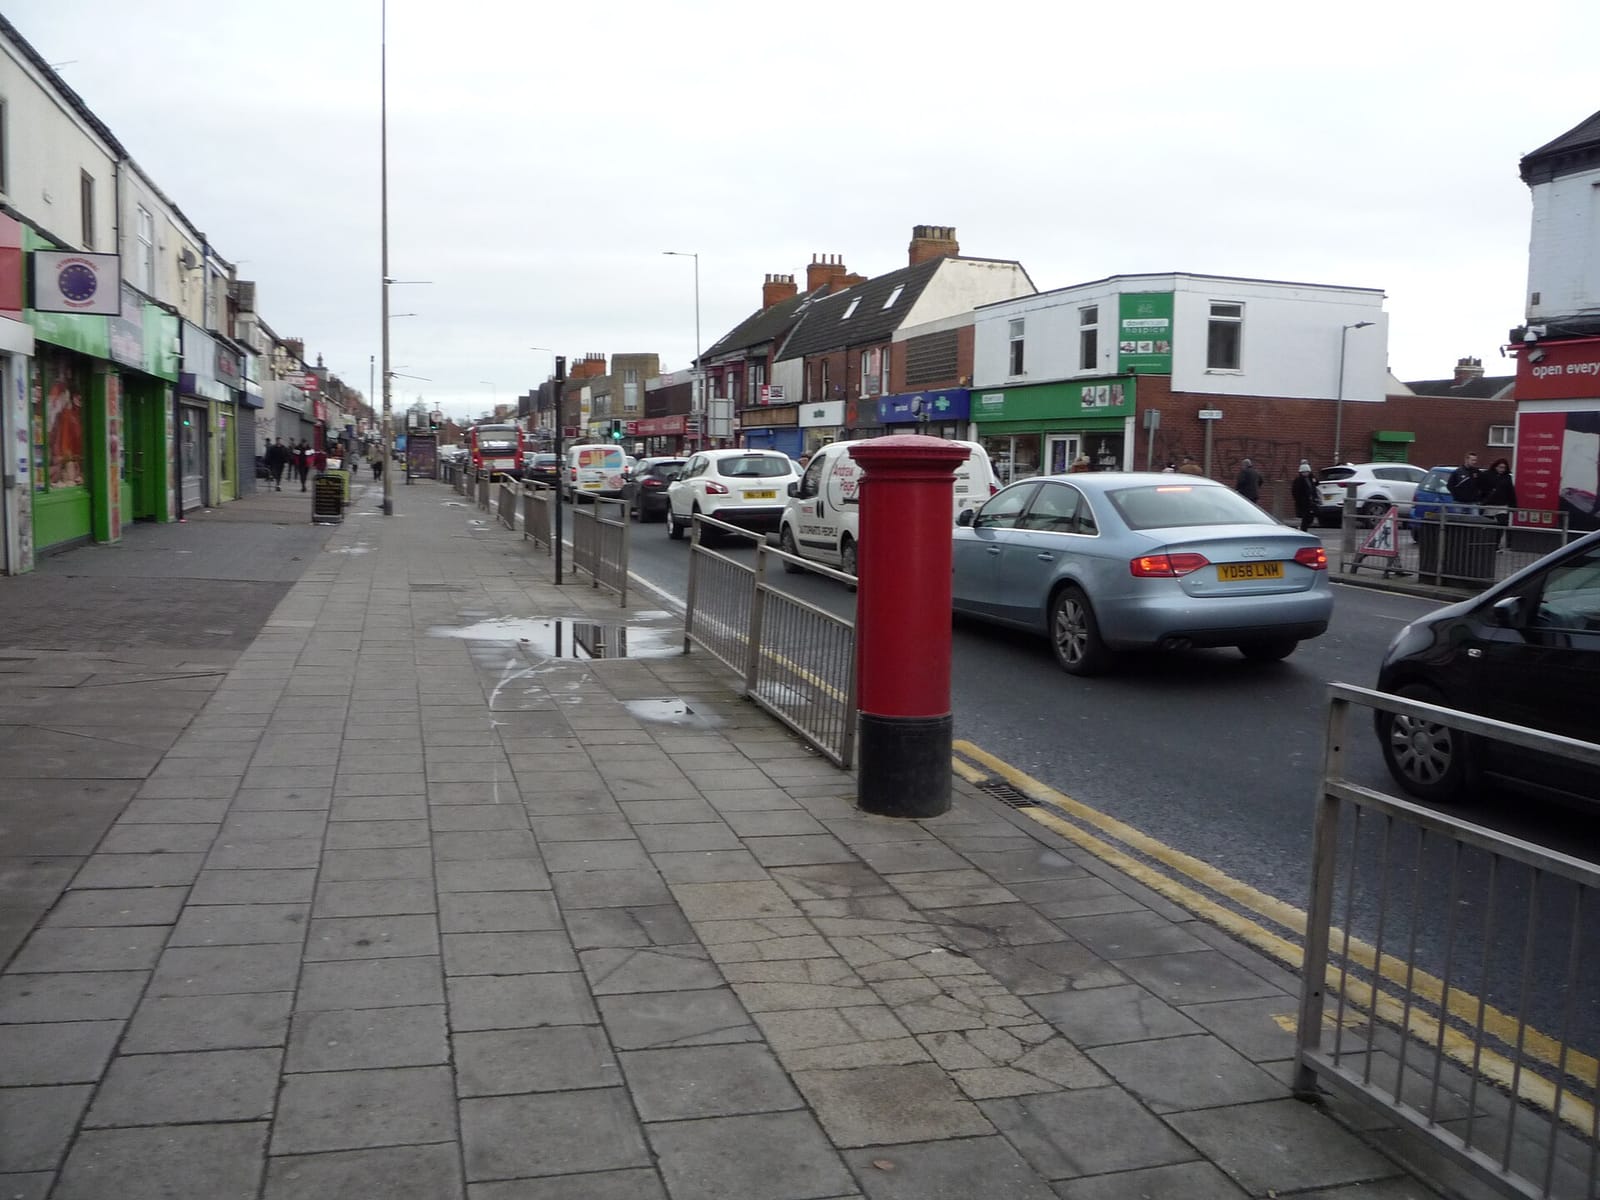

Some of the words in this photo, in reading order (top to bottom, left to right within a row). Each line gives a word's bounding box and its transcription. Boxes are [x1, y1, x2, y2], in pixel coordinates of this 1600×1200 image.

[1125, 326, 1166, 335] hospice
[1532, 364, 1562, 379] open
[1566, 362, 1600, 376] every
[840, 478, 855, 493] Page
[1222, 565, 1254, 578] YD58
